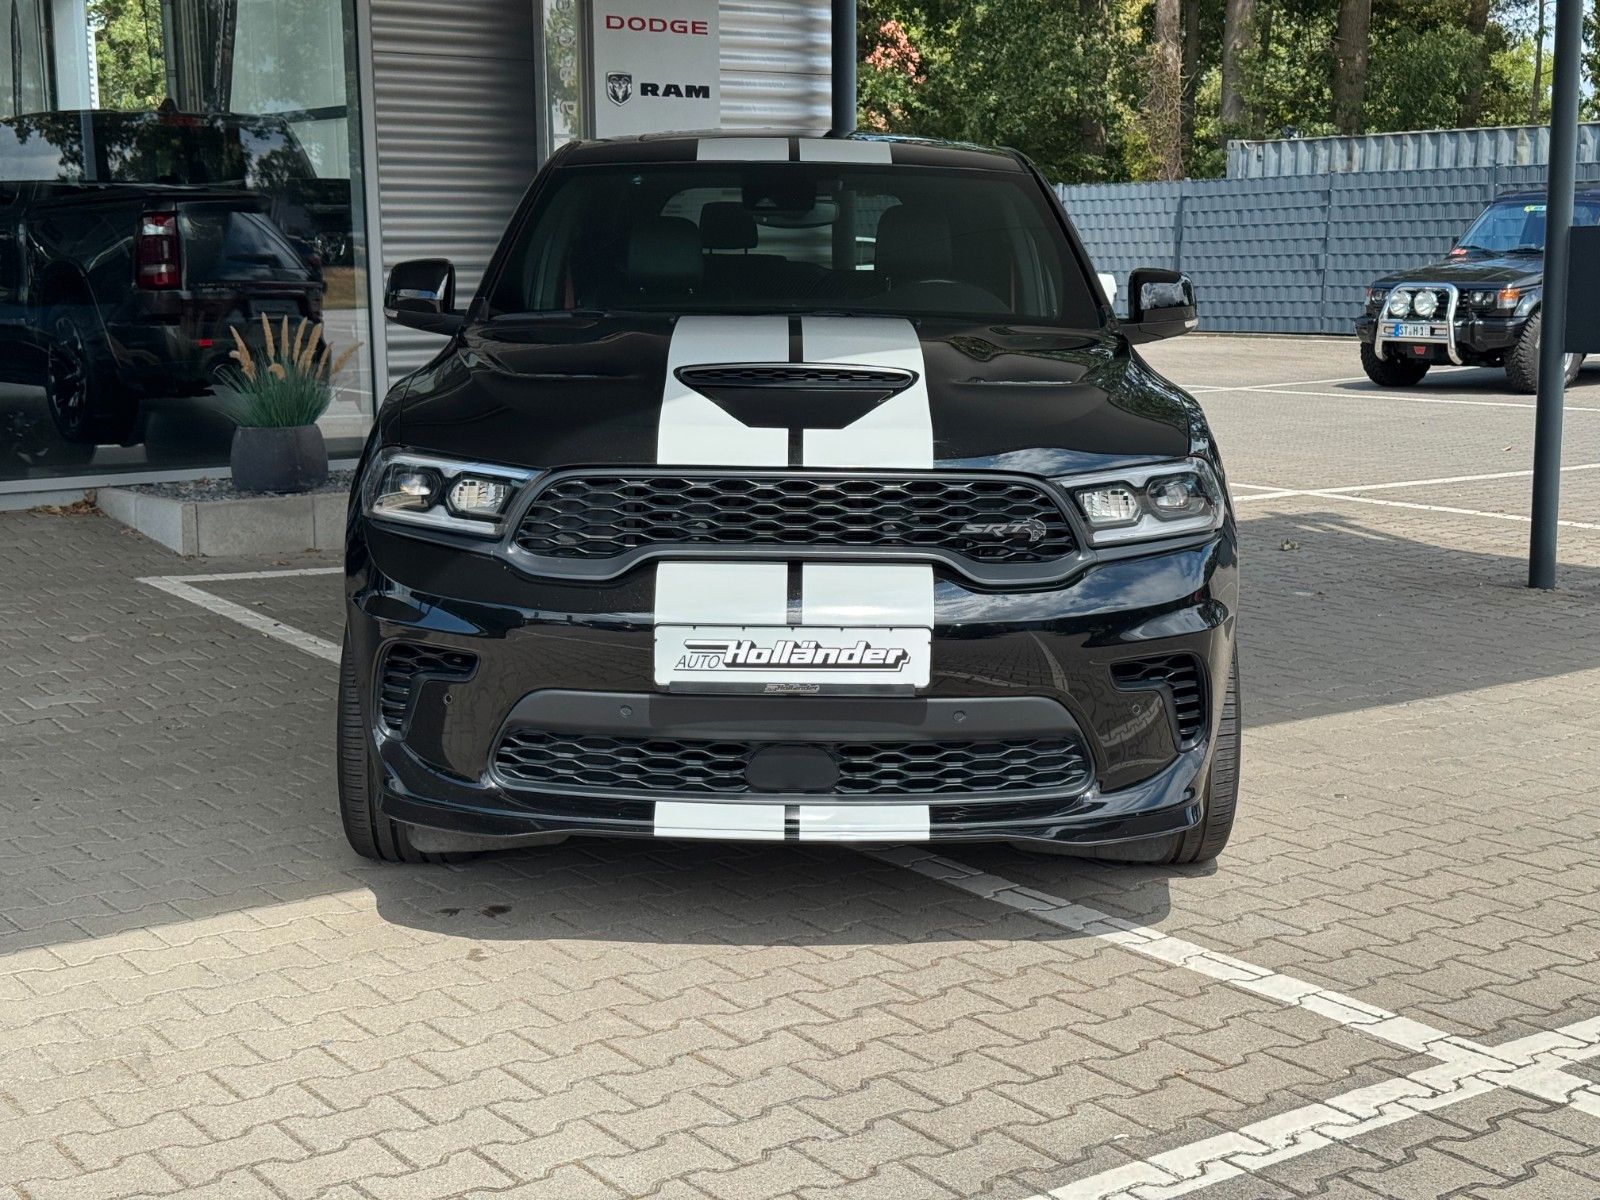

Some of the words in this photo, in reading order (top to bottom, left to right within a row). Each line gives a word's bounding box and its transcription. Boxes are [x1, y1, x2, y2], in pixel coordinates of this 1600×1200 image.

[605, 15, 709, 35] DODGE
[640, 82, 710, 98] RAM
[960, 523, 1031, 537] SRT
[675, 654, 721, 669] AUTO
[722, 640, 909, 668] Holländer
